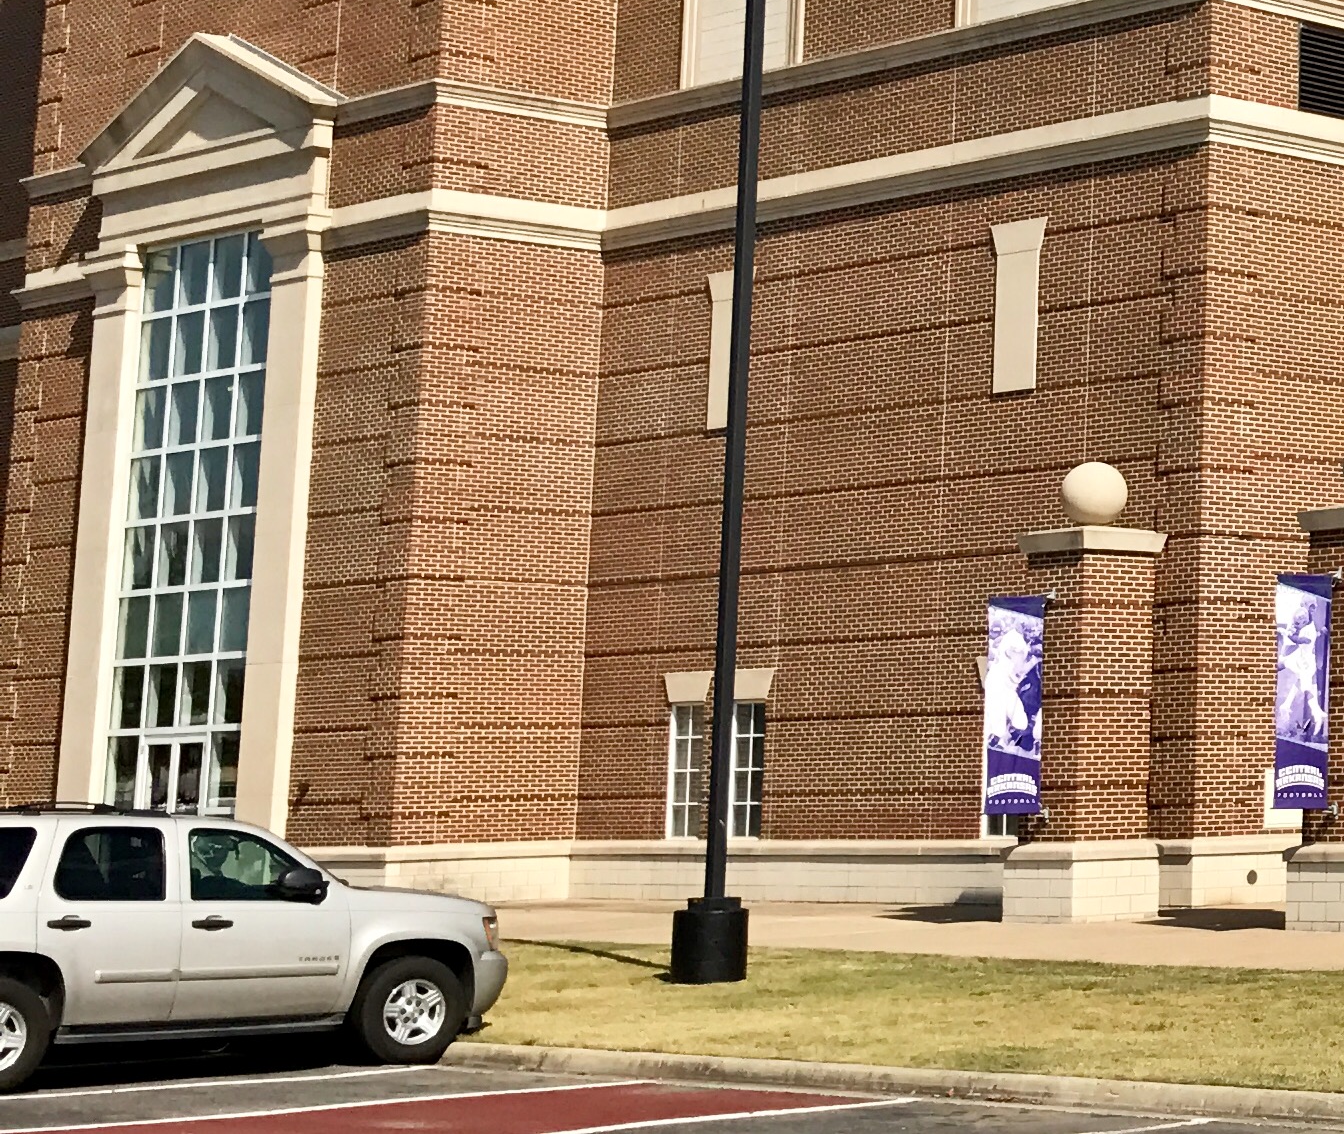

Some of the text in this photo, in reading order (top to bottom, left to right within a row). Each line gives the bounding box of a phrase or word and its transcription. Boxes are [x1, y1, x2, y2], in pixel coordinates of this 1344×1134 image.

[1278, 764, 1323, 778] CENTRAL
[990, 773, 1036, 786] CENTRAL
[1275, 773, 1325, 788] ARKANSAS
[987, 782, 1038, 796] ARKANSAS
